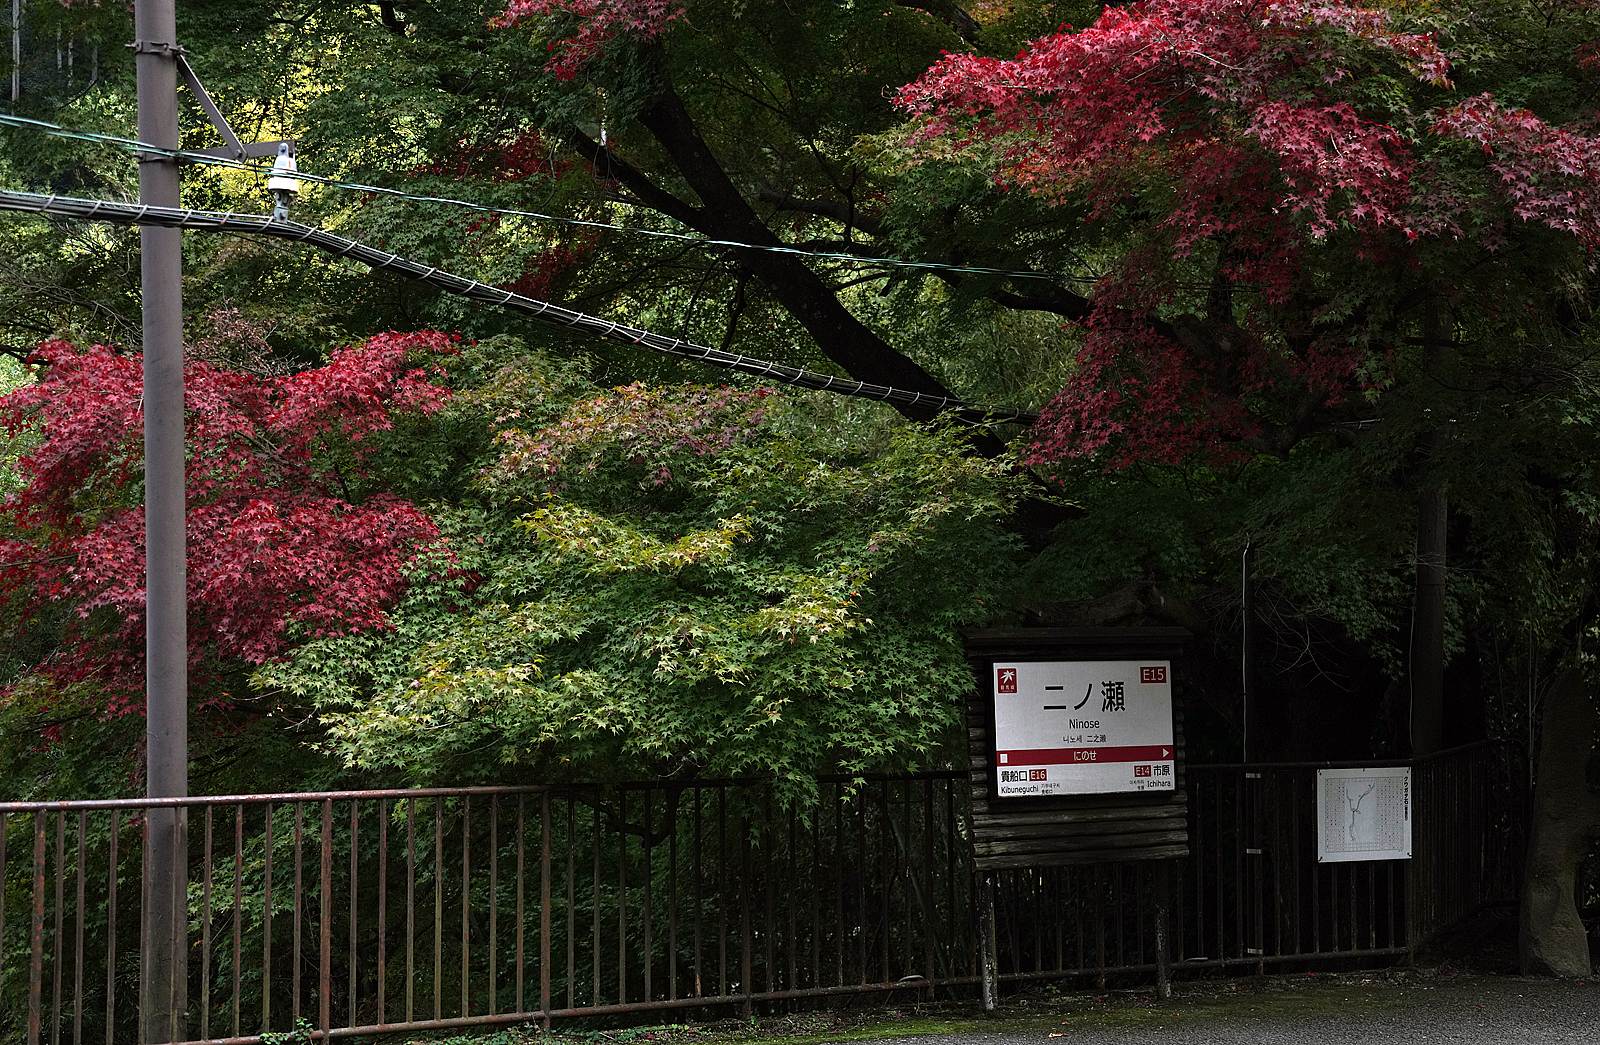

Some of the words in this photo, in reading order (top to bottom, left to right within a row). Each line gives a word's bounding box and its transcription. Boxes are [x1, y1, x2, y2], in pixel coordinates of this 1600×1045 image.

[1143, 669, 1164, 681] E15
[1043, 680, 1126, 713] 二ノ瀬
[1069, 718, 1100, 729] Ninose
[1073, 750, 1097, 761] にのせ
[1030, 770, 1046, 780] E16
[1135, 766, 1150, 775] E14
[1153, 764, 1171, 776] 市原
[1001, 770, 1028, 783] 貴船口
[1001, 784, 1039, 794] Kibuneguchi
[1147, 780, 1171, 788] Ichihara
